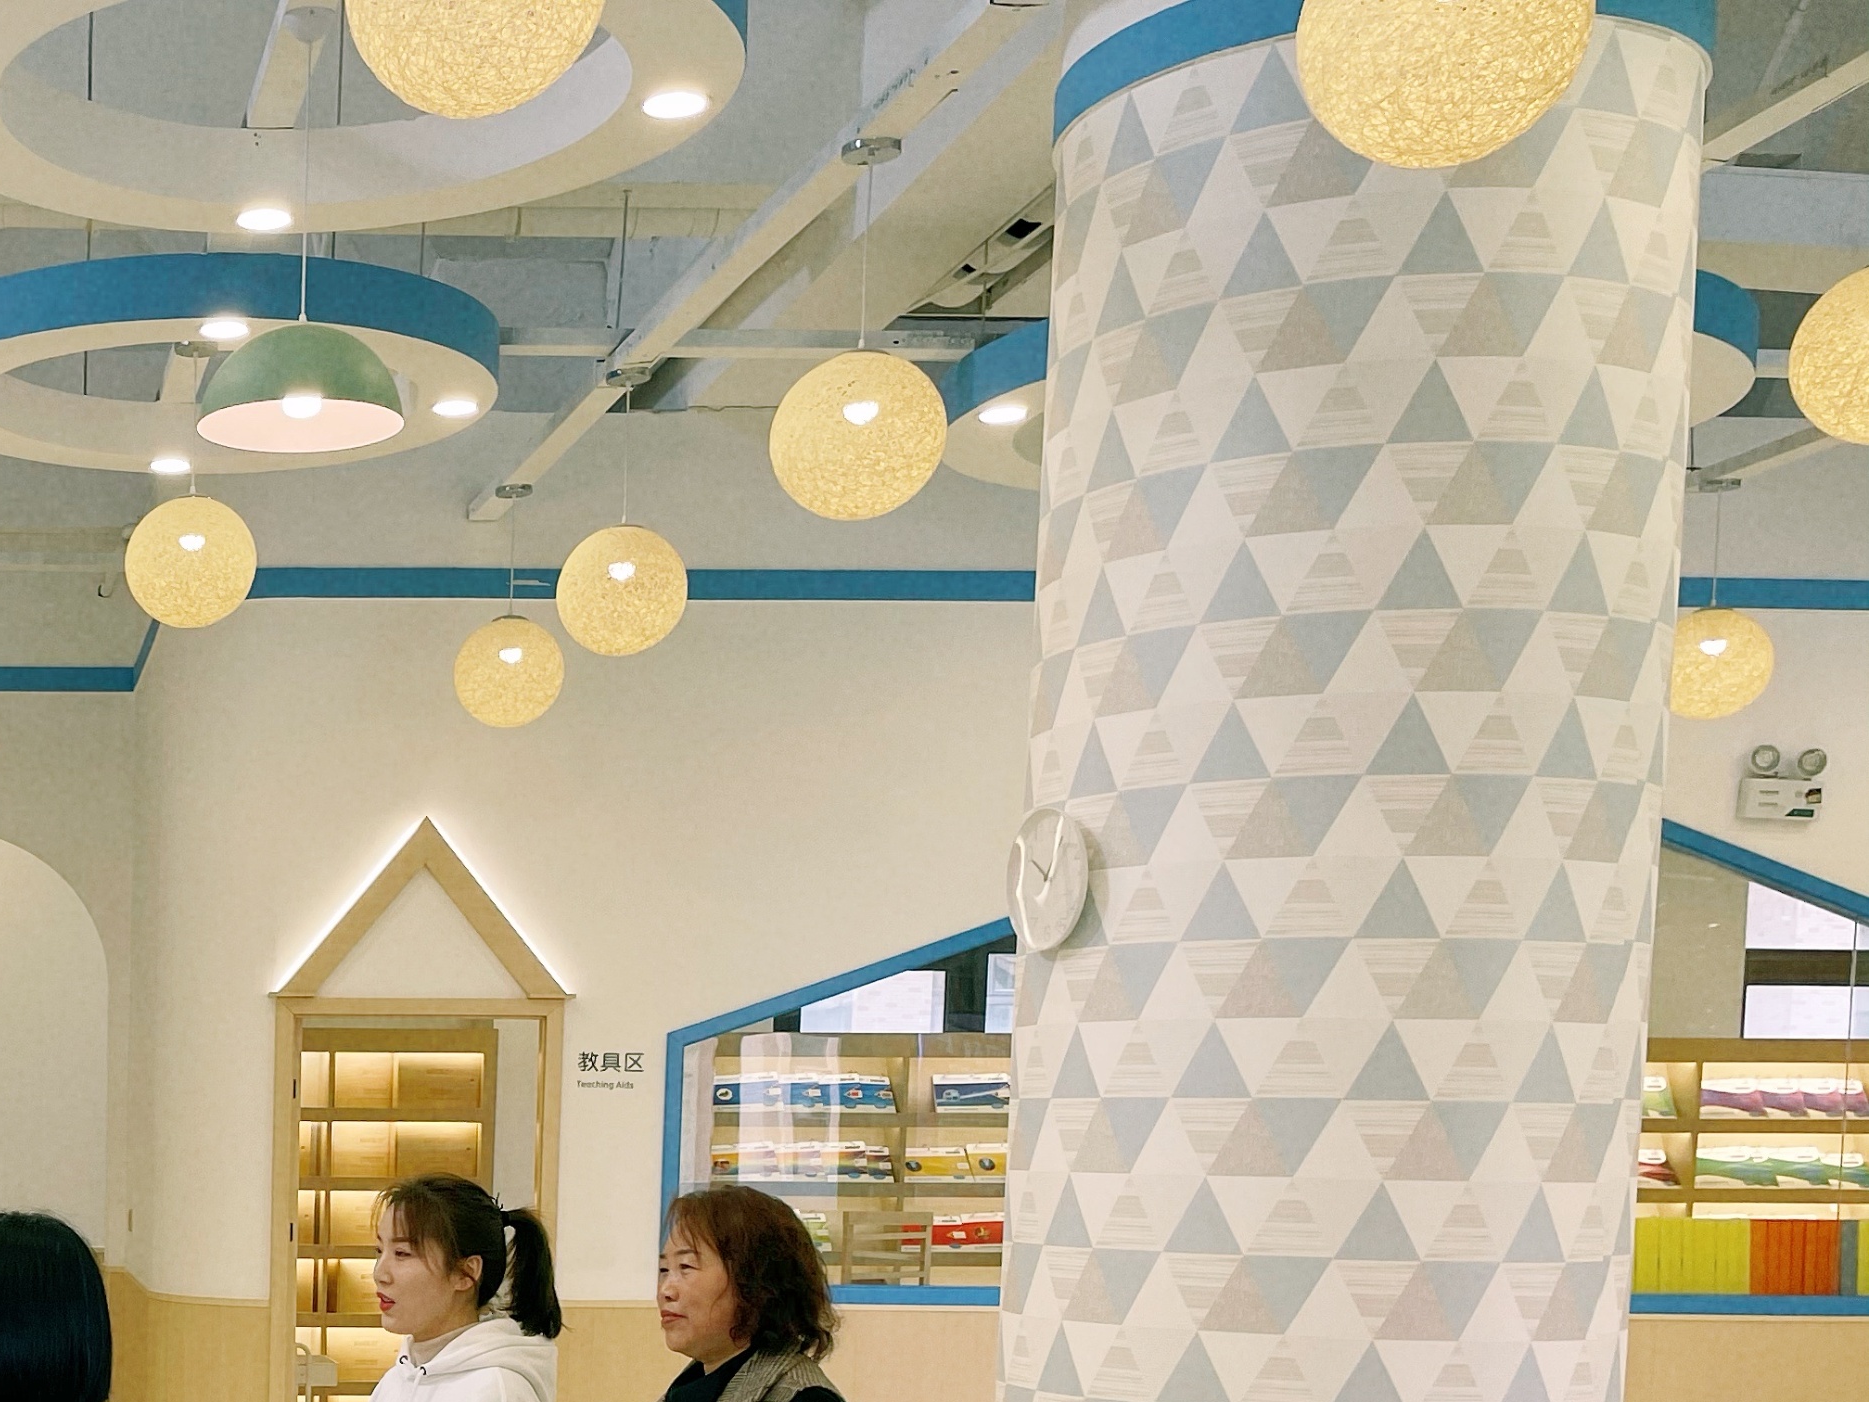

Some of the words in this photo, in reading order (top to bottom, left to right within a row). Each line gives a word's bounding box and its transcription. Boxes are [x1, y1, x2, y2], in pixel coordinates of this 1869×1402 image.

[577, 1051, 645, 1073] 教具区
[576, 1080, 614, 1090] Teaching
[615, 1081, 634, 1090] Aids
